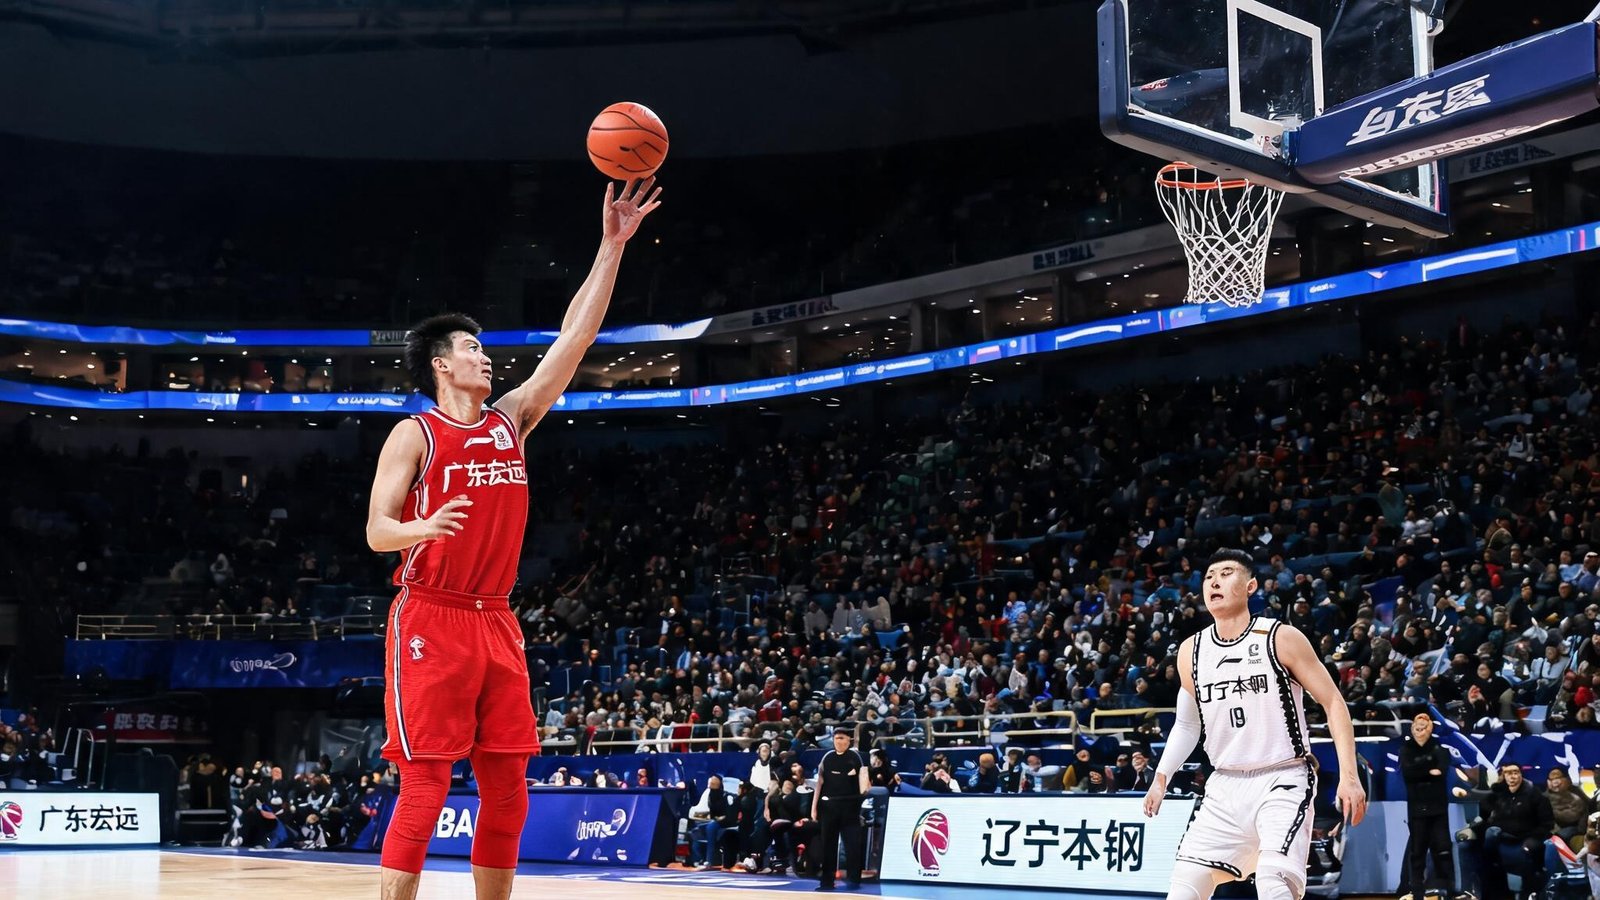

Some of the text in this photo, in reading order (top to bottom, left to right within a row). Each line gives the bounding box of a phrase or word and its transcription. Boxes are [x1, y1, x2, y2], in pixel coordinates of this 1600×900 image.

[1229, 706, 1246, 729] 19
[39, 804, 140, 833] 广东宏远
[980, 817, 1146, 873] 辽宁本钢
